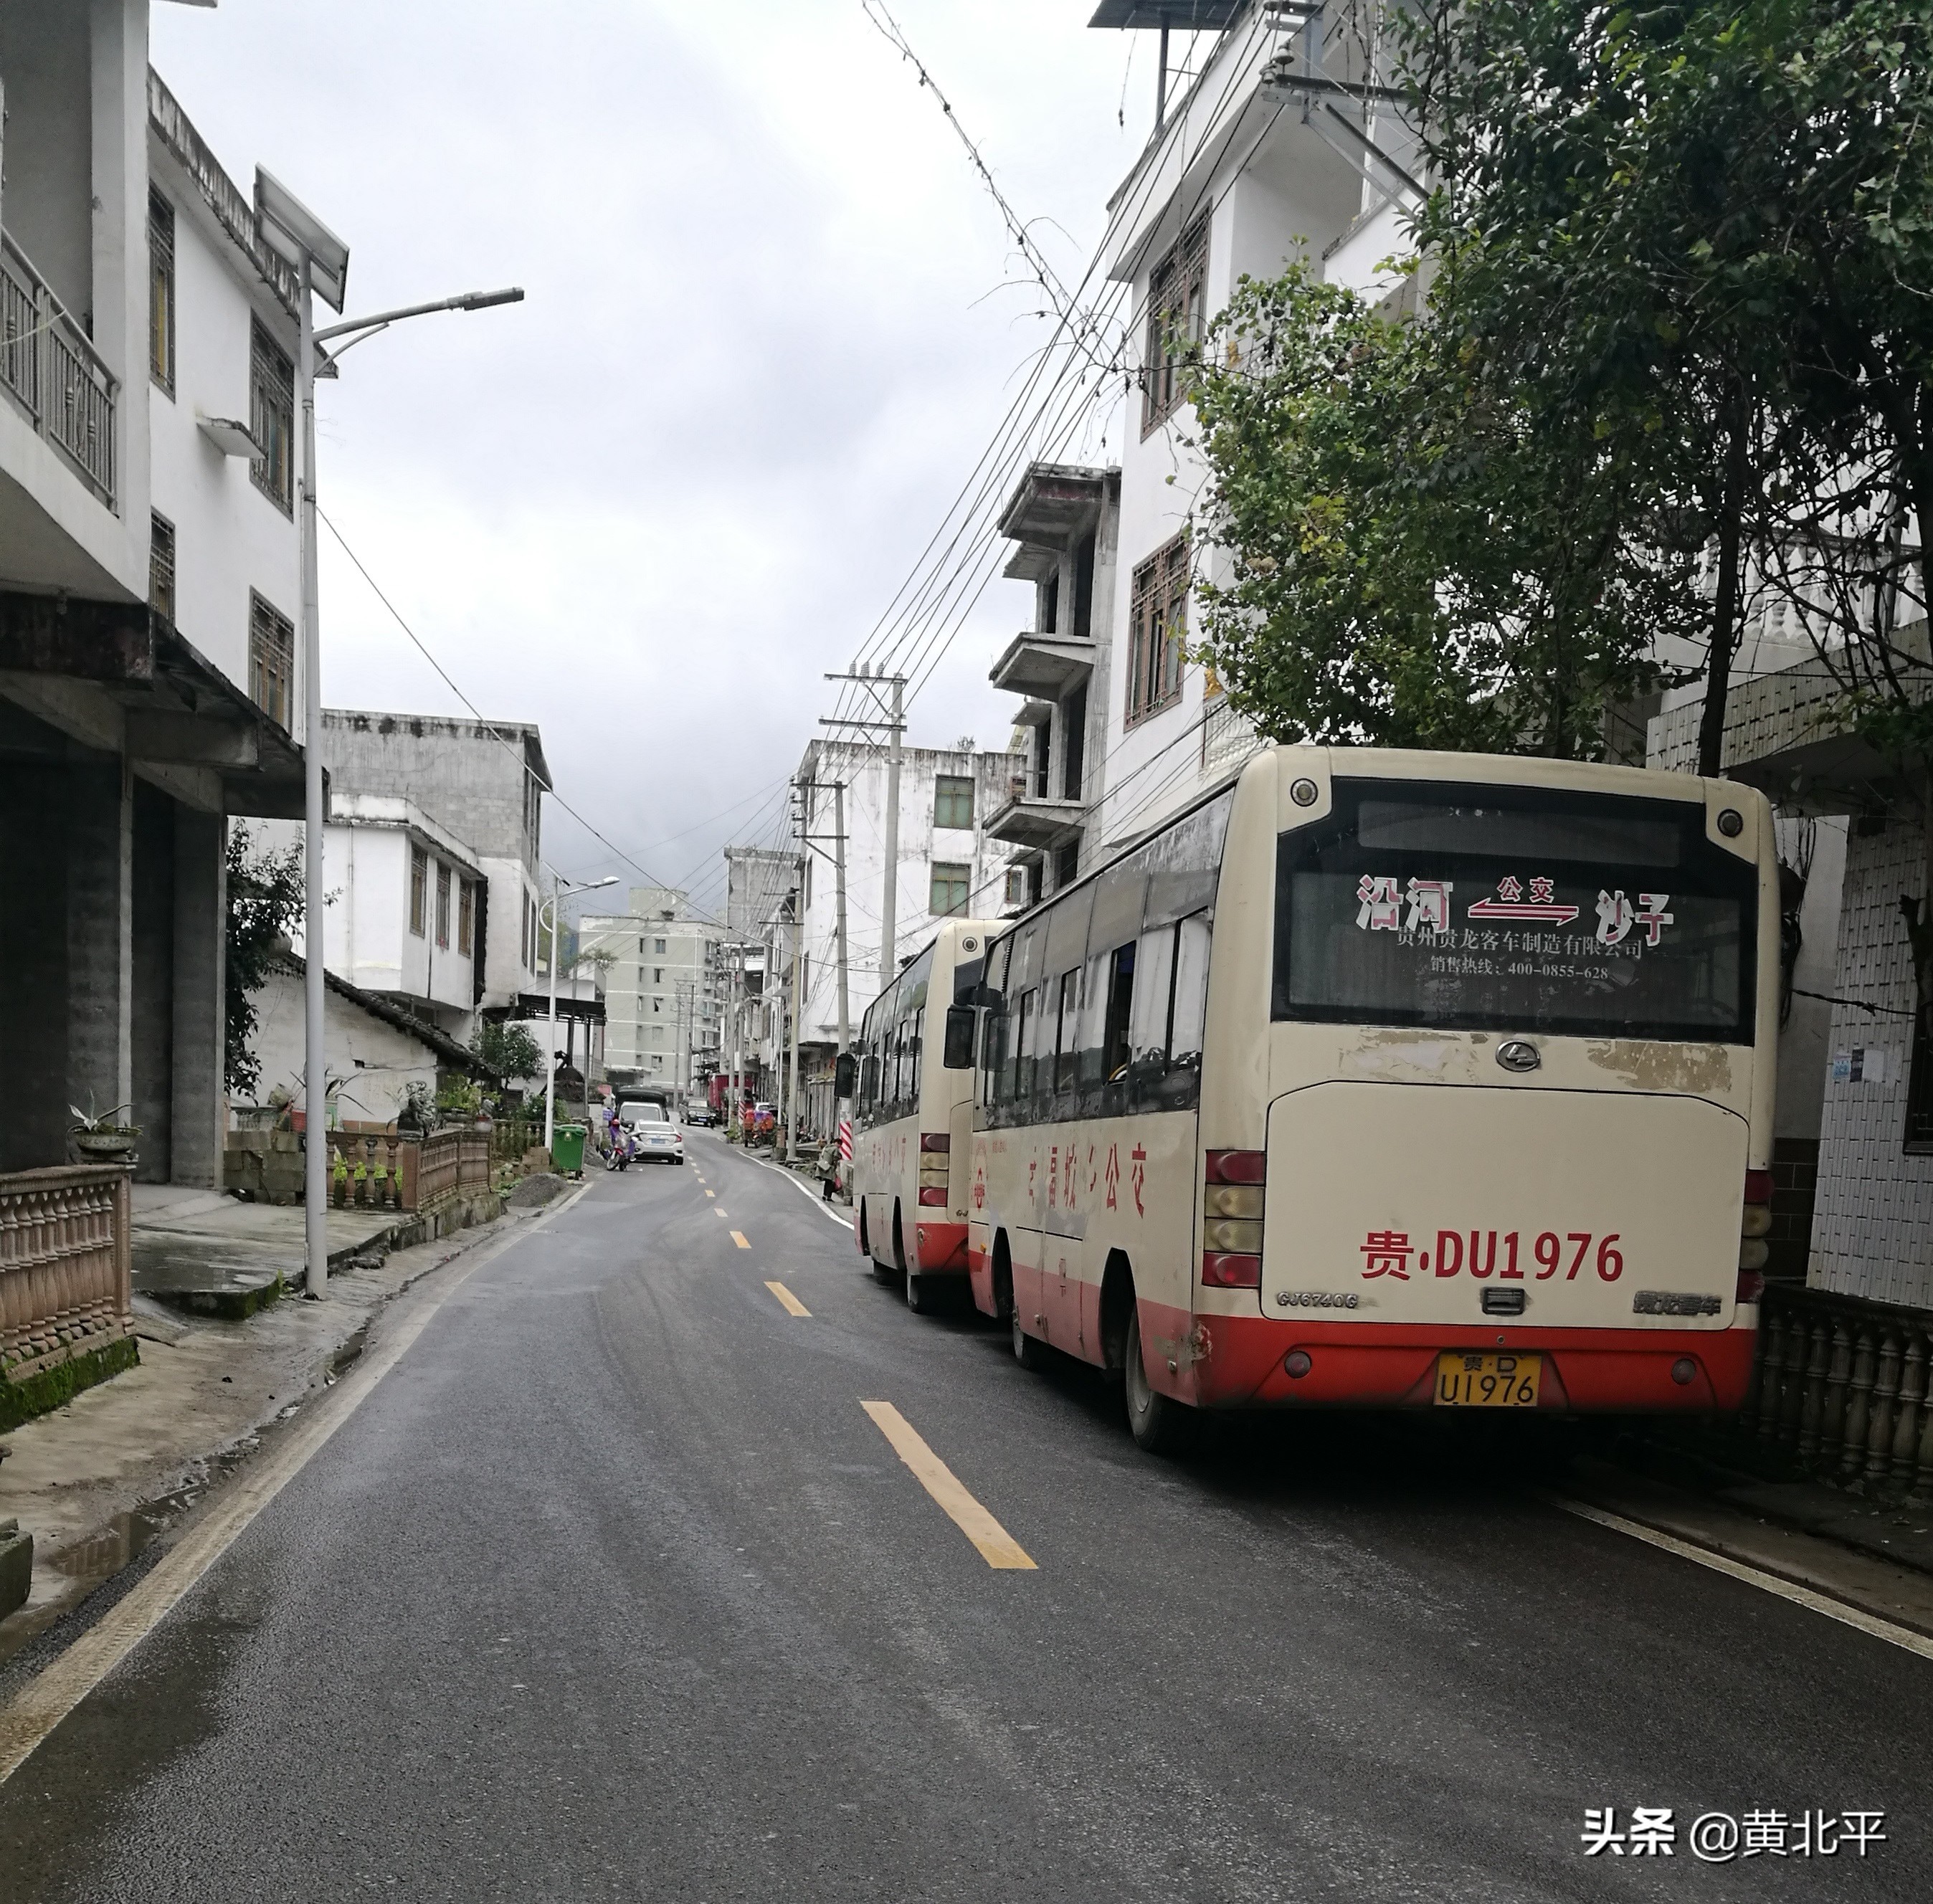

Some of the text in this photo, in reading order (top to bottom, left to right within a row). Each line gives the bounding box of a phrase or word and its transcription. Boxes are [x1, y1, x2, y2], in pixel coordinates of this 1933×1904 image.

[1356, 875, 1674, 946] 沿河 公交 沙子
[1359, 1230, 1623, 1282] 贵·DU1976
[1276, 1291, 1359, 1308] GJ6740G
[1440, 1374, 1533, 1403] U1976
